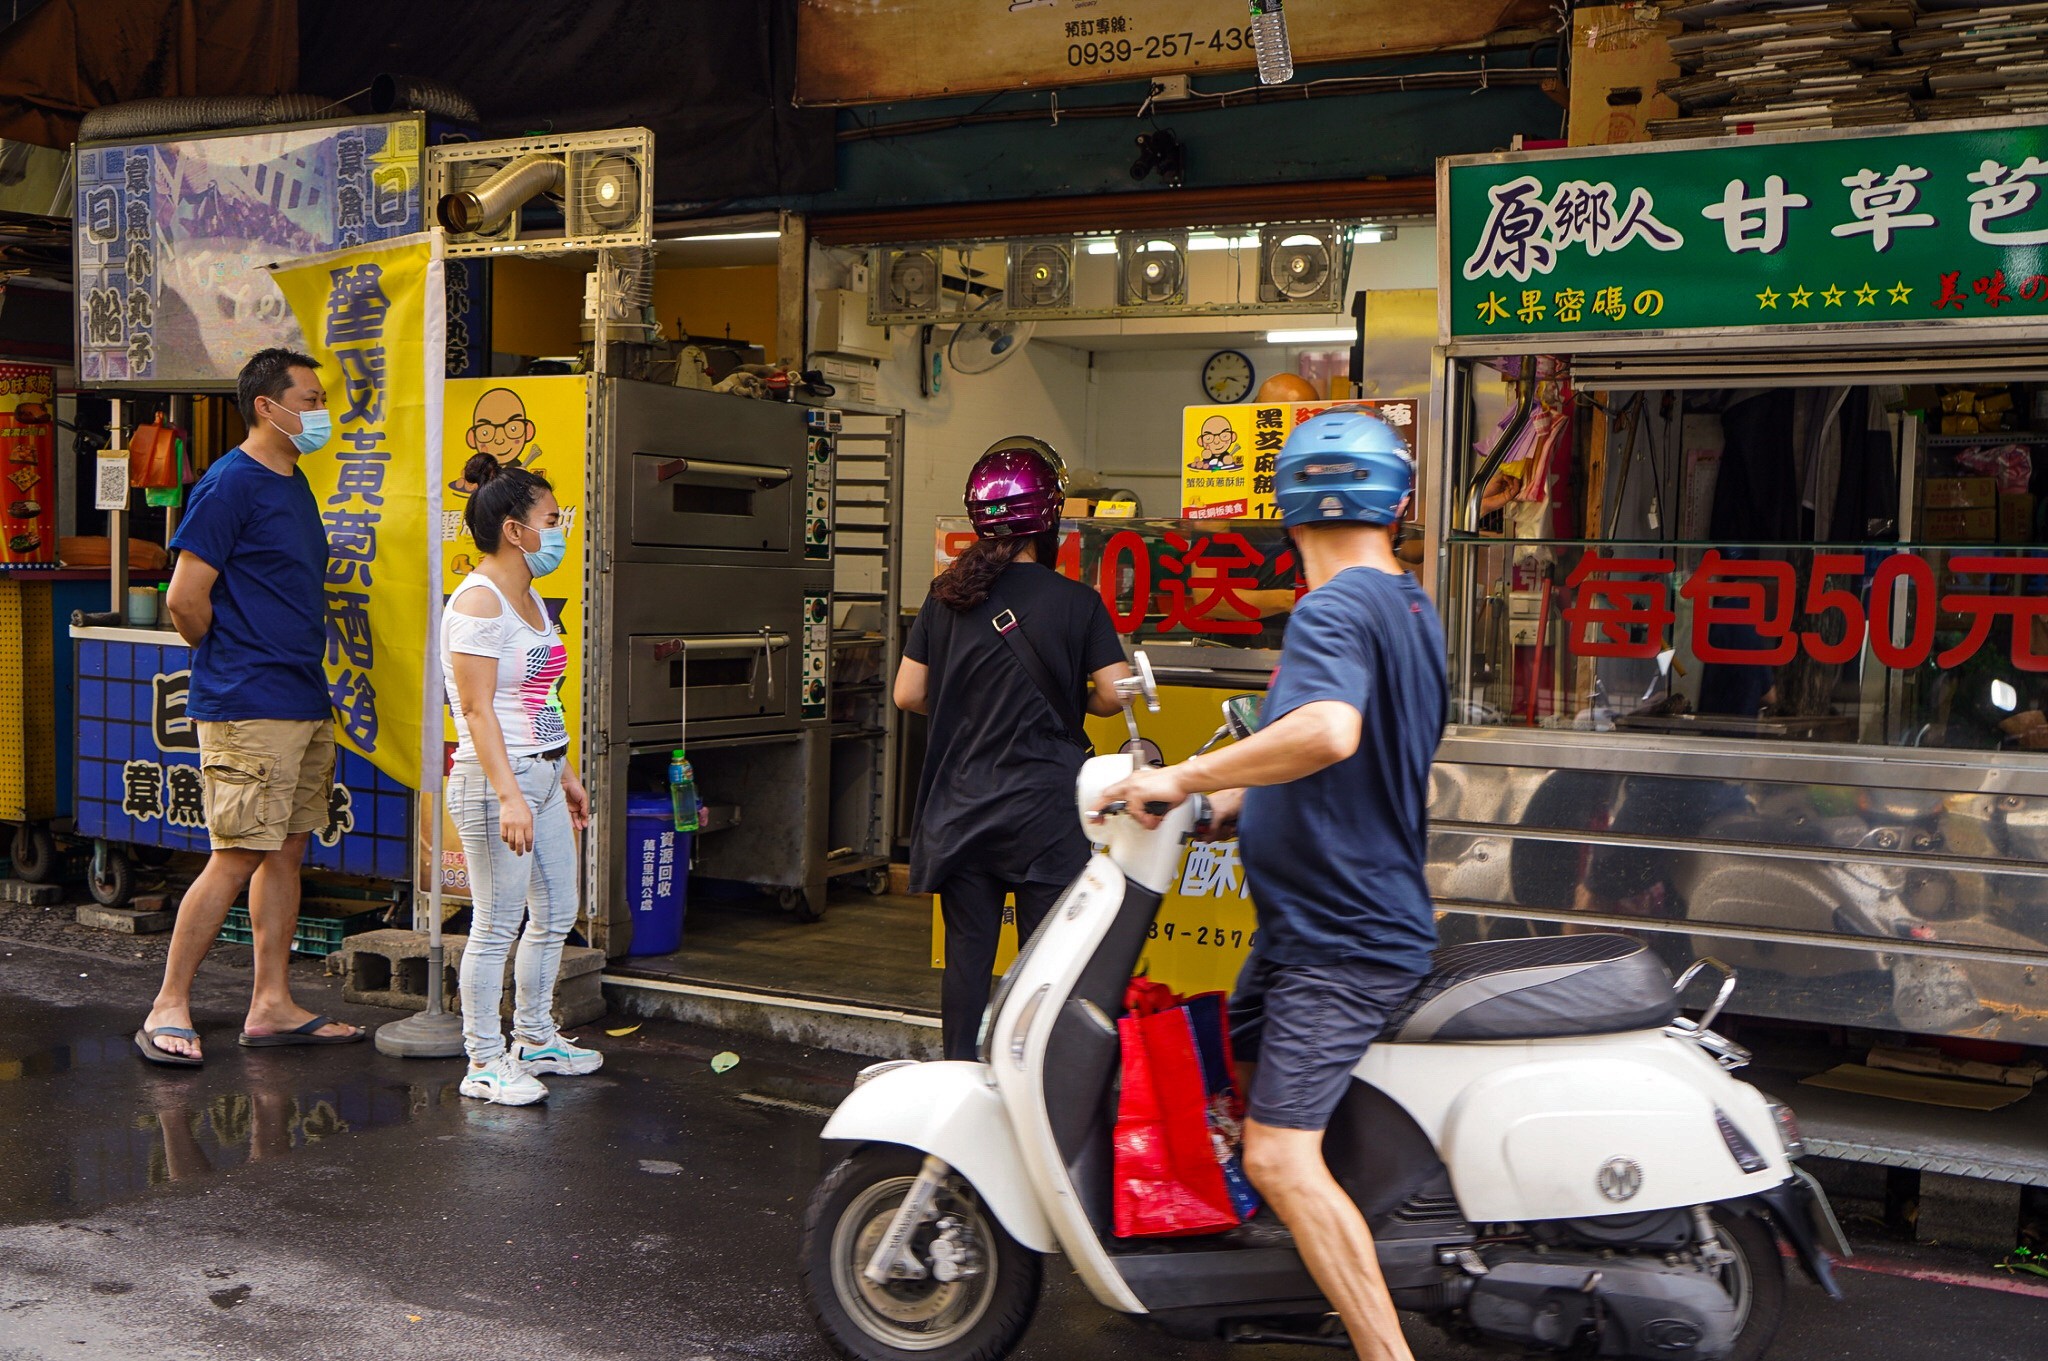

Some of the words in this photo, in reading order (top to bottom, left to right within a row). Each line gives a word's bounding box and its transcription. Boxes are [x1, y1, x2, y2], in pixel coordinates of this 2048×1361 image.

[125, 155, 154, 373] 章魚小丸子
[1463, 175, 1684, 283] 原鄉人
[1477, 286, 1664, 325] 水果密碼の
[1562, 549, 2048, 672] 每包50元
[122, 760, 354, 847] 章魚子
[657, 832, 674, 897] 資源回收
